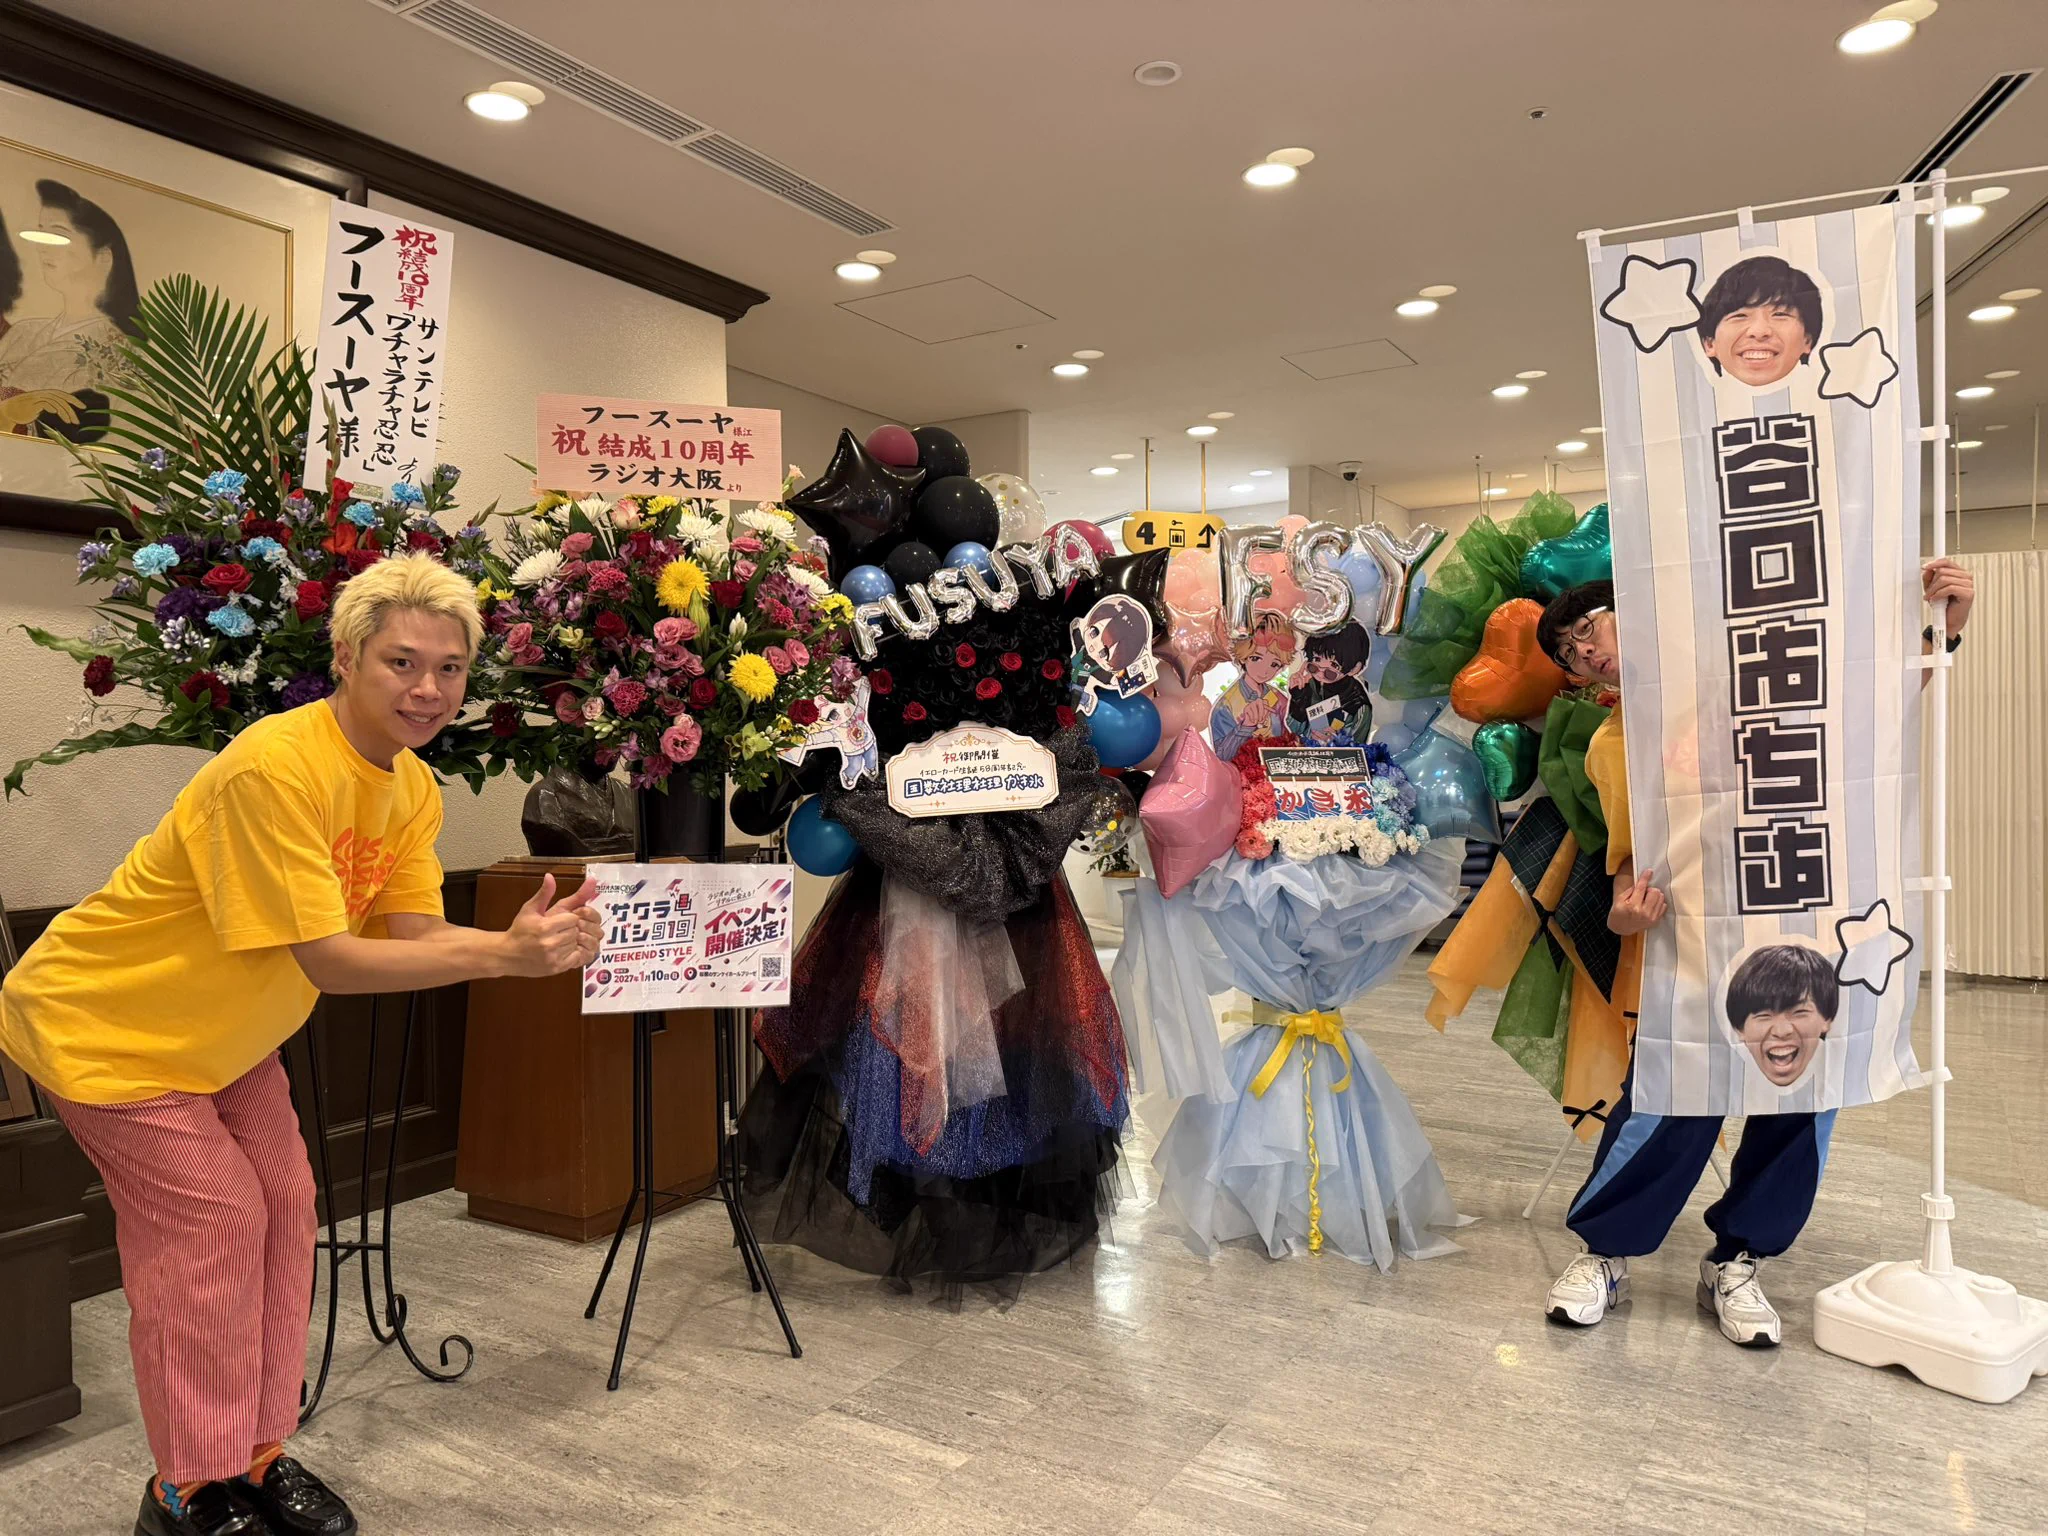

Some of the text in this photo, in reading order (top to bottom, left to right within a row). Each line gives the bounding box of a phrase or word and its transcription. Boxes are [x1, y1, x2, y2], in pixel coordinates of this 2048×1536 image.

[316, 220, 385, 458] フースーヤ様
[411, 316, 440, 439] サンテレビ
[551, 423, 756, 466] 祝 結成10周年
[1136, 522, 1156, 545] 4
[850, 523, 1103, 662] FUSUYA
[1219, 521, 1449, 639] FSY
[1330, 698, 1338, 709] 2
[1004, 774, 1045, 791] かき氷
[1280, 787, 1372, 814] かき氷
[610, 899, 671, 923] サクラ
[705, 902, 776, 934] イベント
[705, 917, 786, 958] 開催決定!
[601, 946, 693, 964] WEEKEND STYLE
